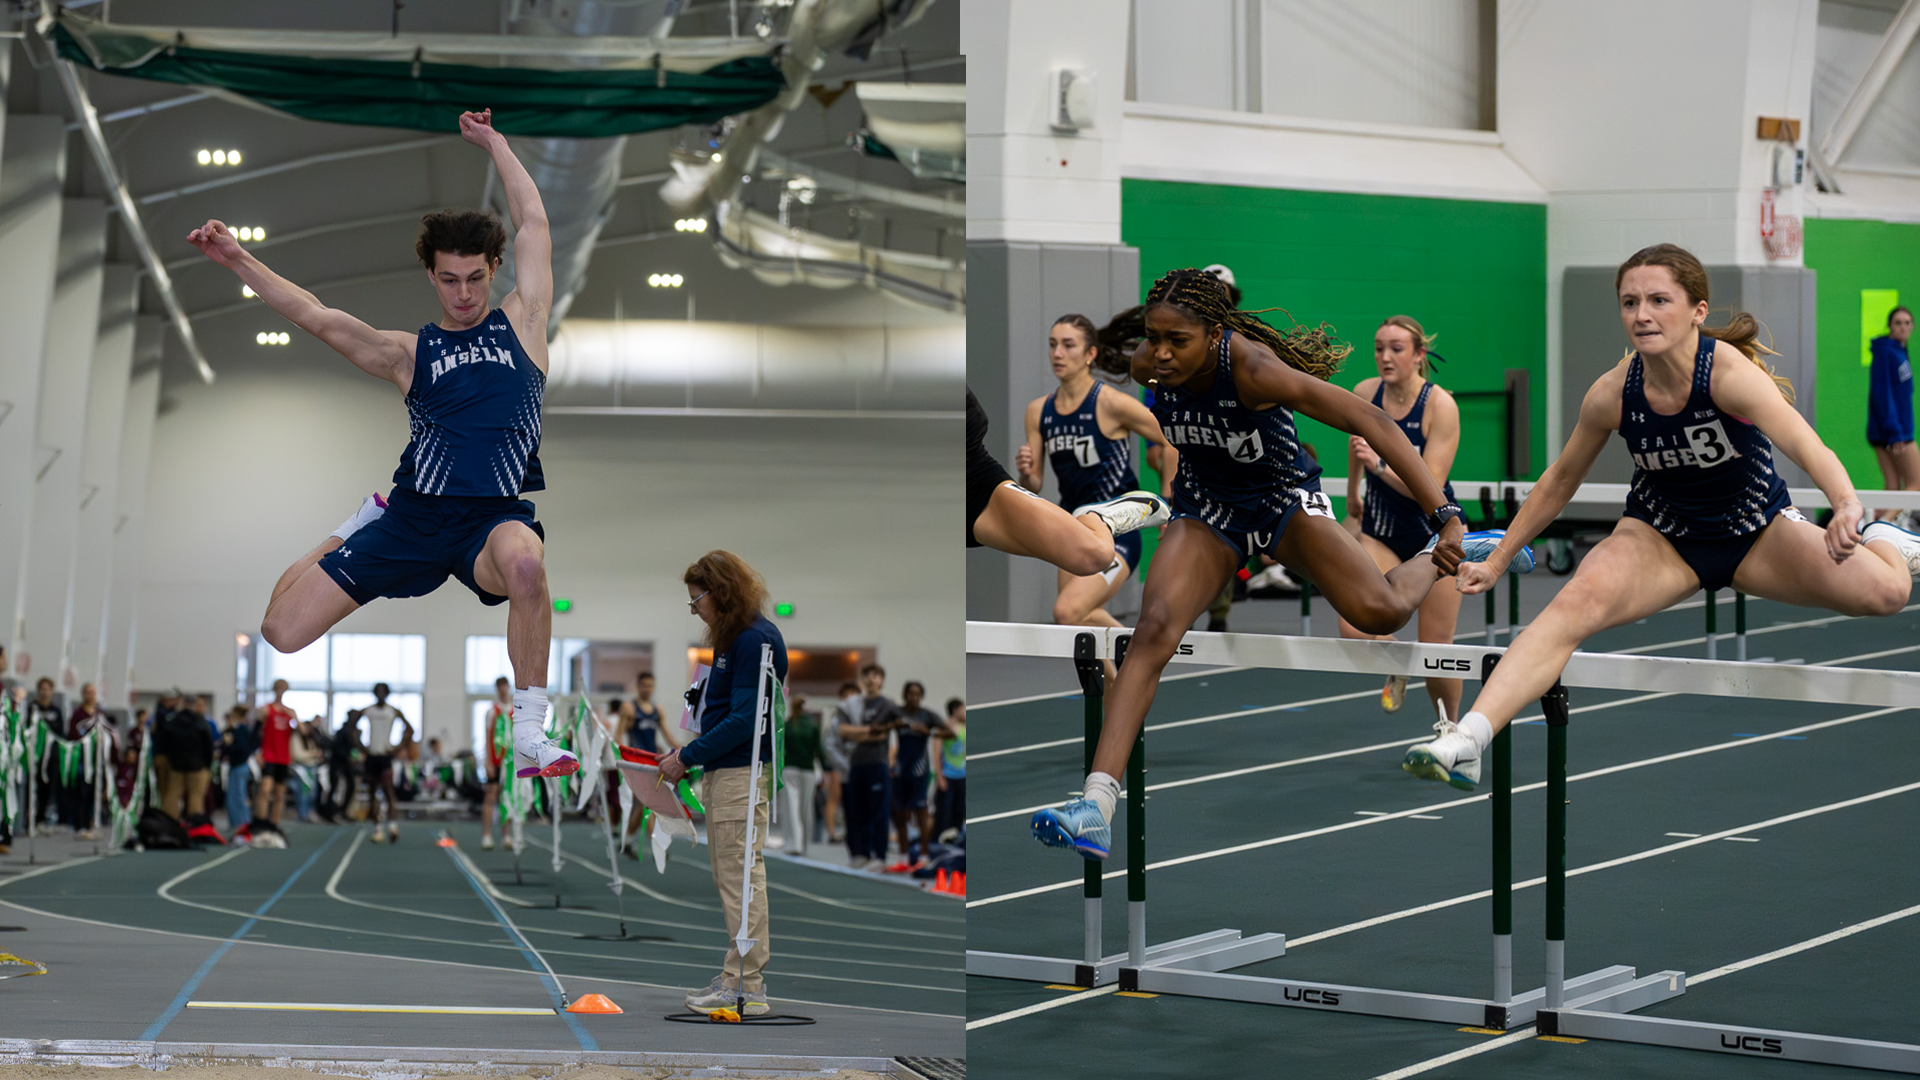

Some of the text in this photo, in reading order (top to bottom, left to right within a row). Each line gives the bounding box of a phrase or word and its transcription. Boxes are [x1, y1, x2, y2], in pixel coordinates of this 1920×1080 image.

[440, 335, 497, 357] SAINT
[430, 346, 517, 385] ANSELM
[1171, 410, 1229, 429] SAINT
[1076, 439, 1090, 465] 7
[1234, 434, 1260, 461] 4
[1691, 426, 1726, 464] 3
[1423, 657, 1472, 672] UCS
[1283, 986, 1341, 1006] UCS
[1720, 1033, 1783, 1054] UCS
